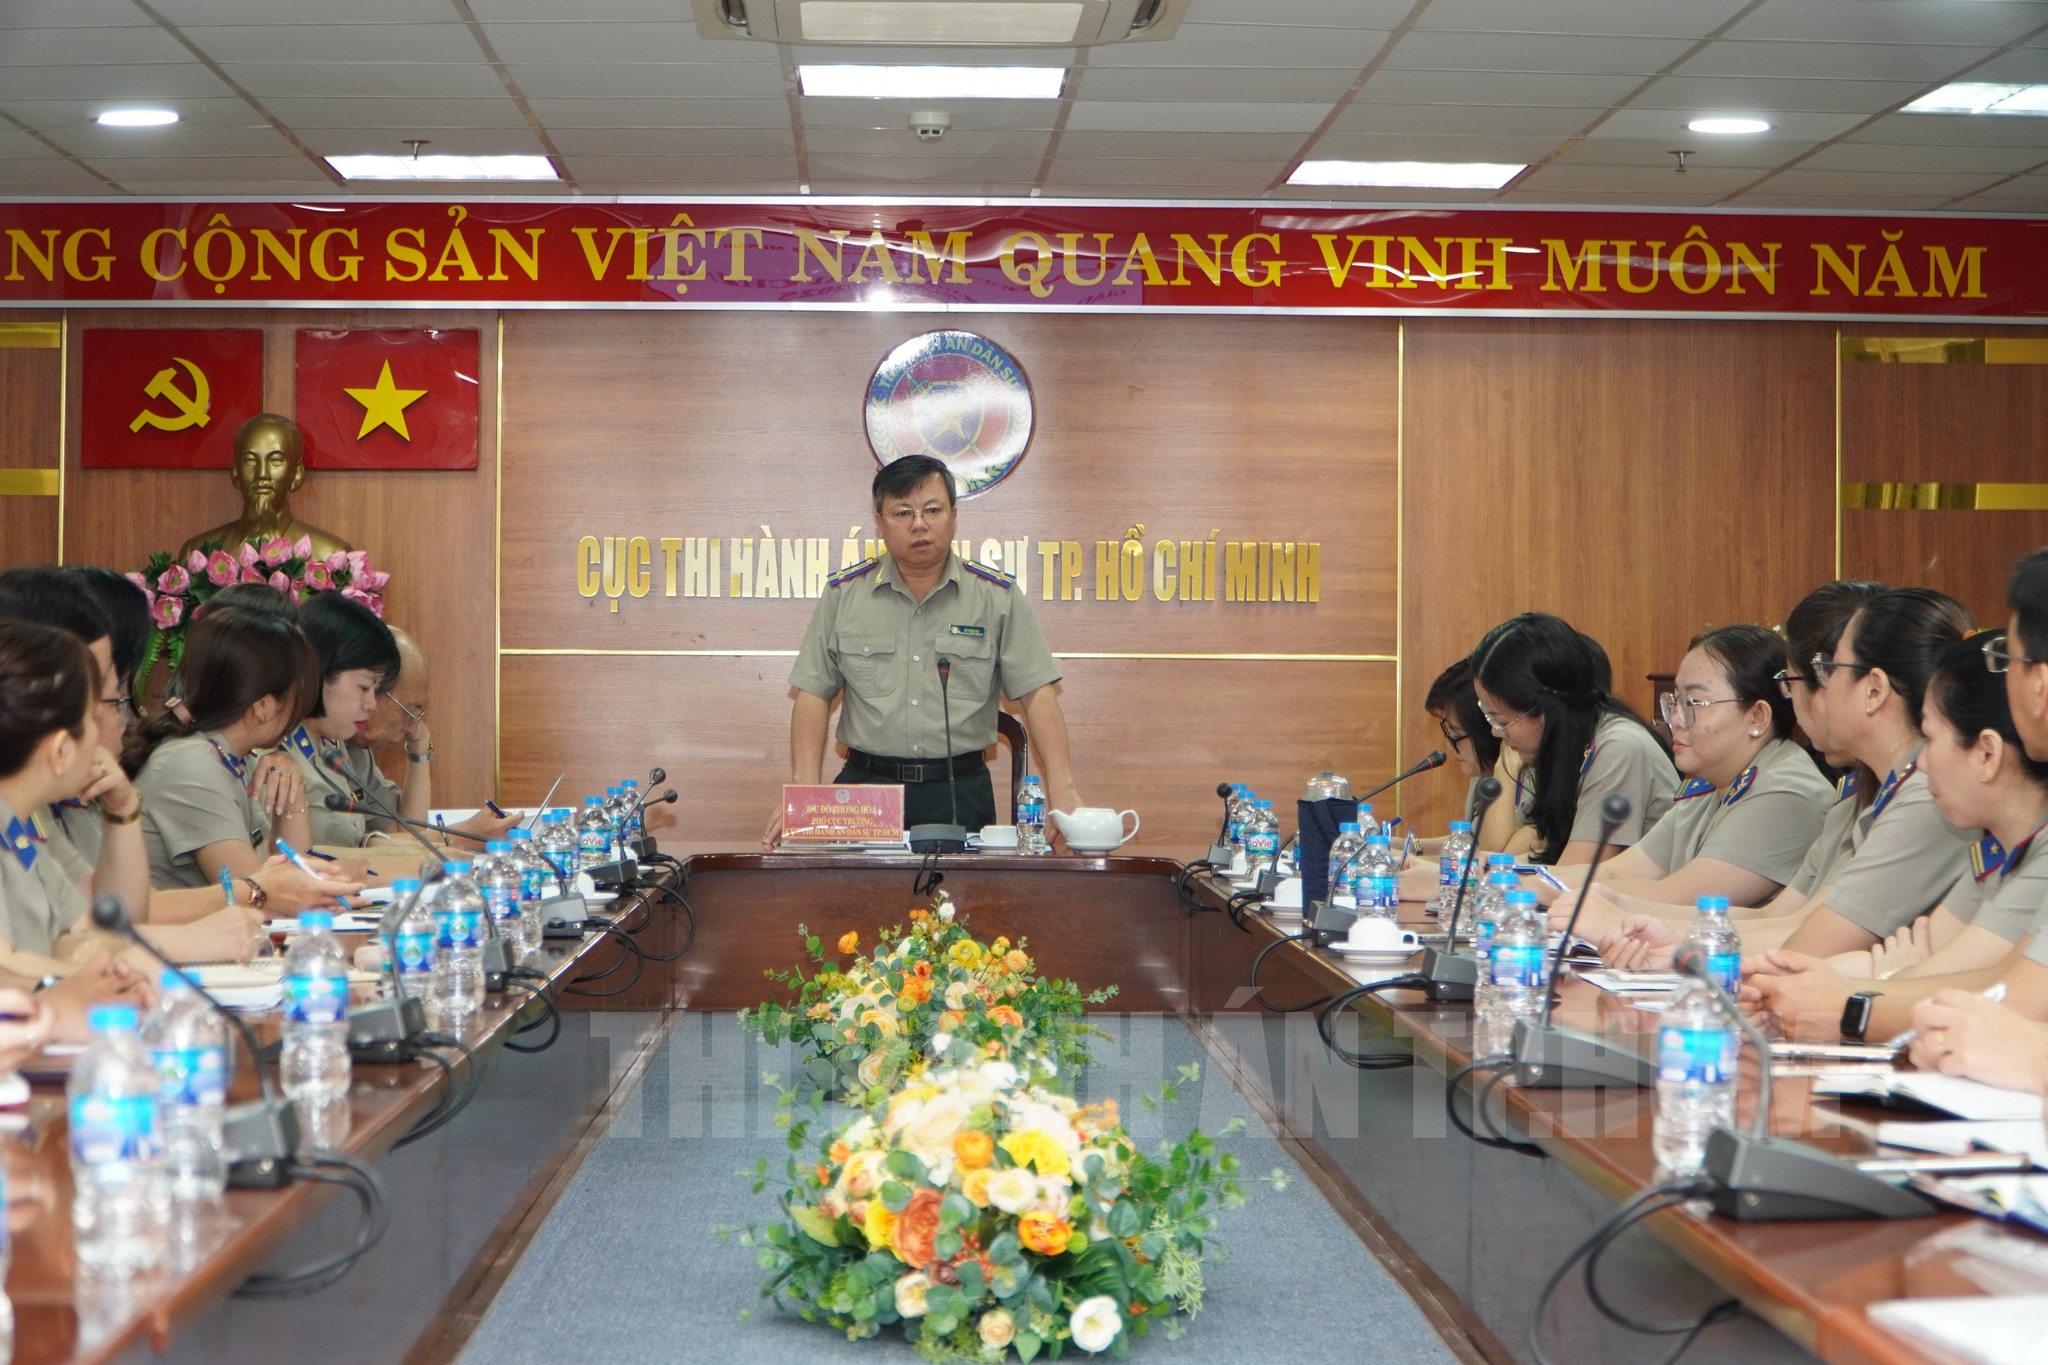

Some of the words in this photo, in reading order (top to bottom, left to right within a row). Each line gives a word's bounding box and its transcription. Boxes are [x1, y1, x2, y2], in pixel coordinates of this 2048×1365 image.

[140, 213, 364, 294] CỘNG
[385, 205, 544, 281] SẢN
[571, 213, 762, 294] VIỆT
[793, 229, 972, 284] NAM
[999, 231, 1287, 298] QUANG
[1311, 233, 1513, 290] VINH
[1540, 225, 1782, 294] MUÔN
[1810, 230, 1987, 298] NĂM
[577, 535, 651, 613] CỤC
[660, 537, 721, 597] THI
[729, 525, 830, 599] HÀNH
[1037, 541, 1082, 600] TP.
[1095, 523, 1146, 601] HỒ
[1153, 528, 1220, 601] CHÍ
[1225, 541, 1320, 602] MINH
[834, 805, 859, 815] PHONG
[1249, 838, 1272, 848] laVie
